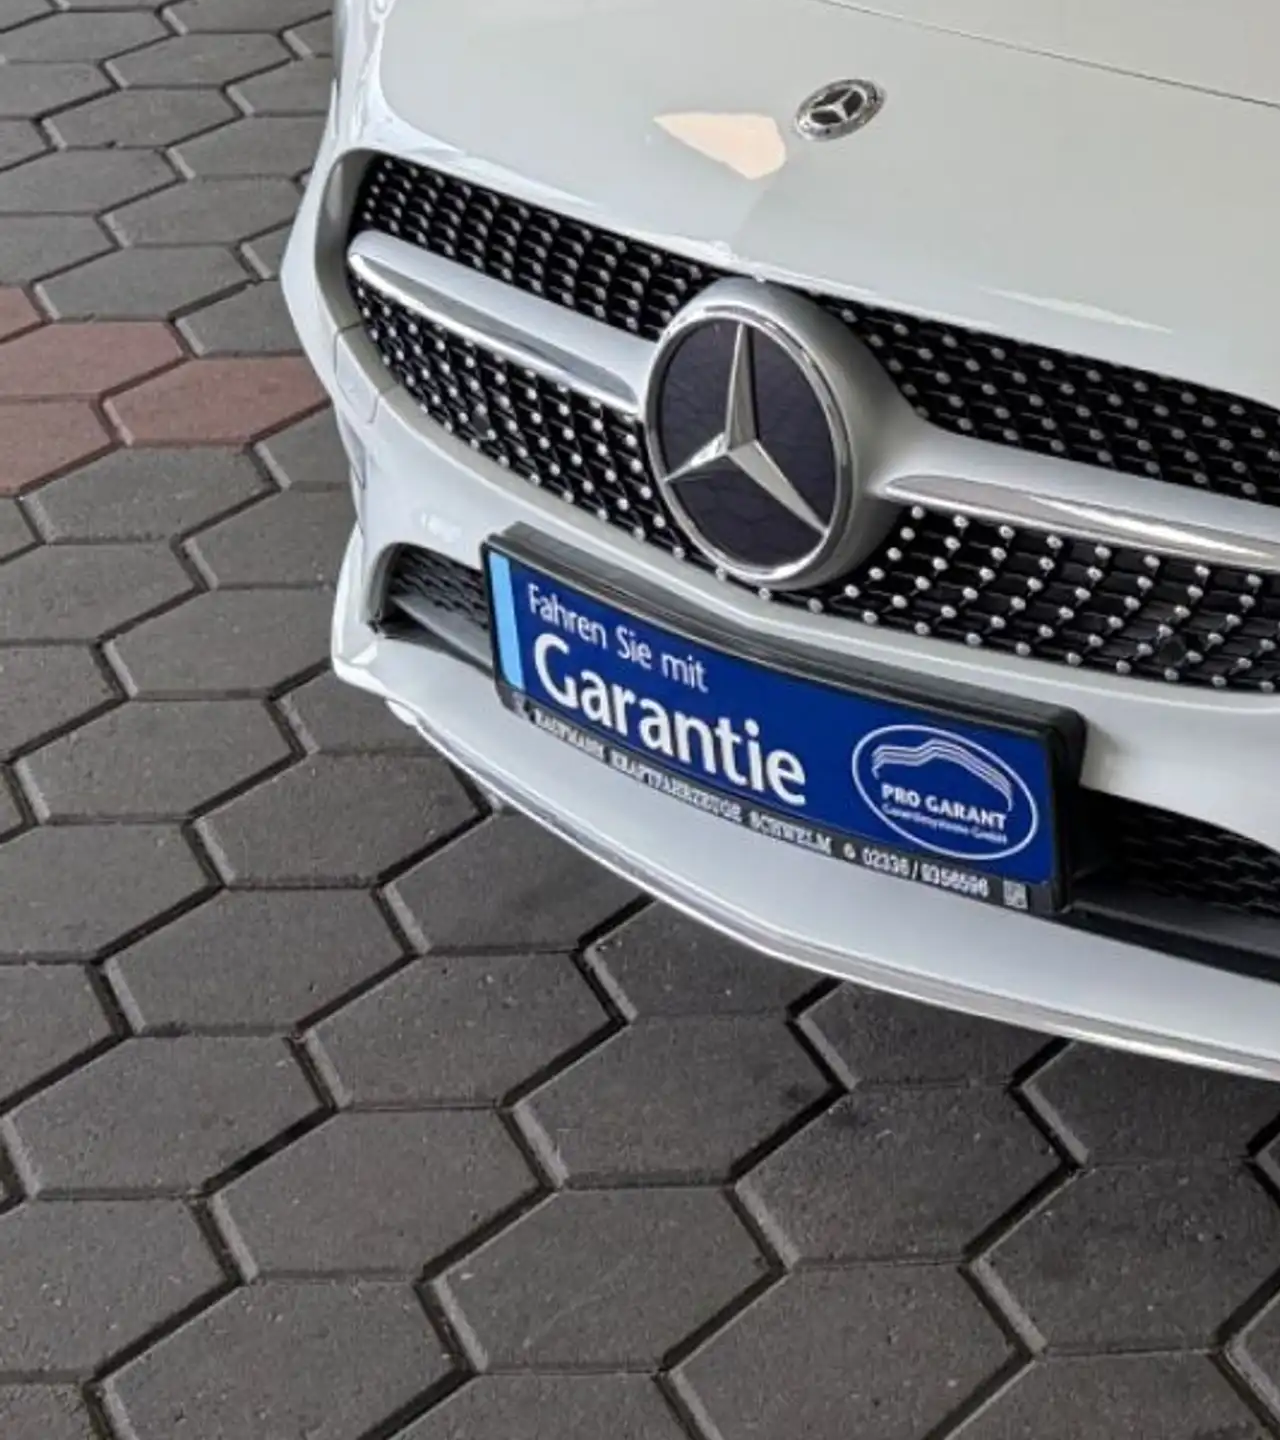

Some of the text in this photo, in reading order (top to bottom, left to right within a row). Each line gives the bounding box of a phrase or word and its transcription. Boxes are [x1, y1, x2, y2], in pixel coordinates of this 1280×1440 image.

[527, 582, 709, 693] Fahren Sie mit
[533, 632, 807, 806] Garantie
[881, 783, 1007, 831] PRO GARANT
